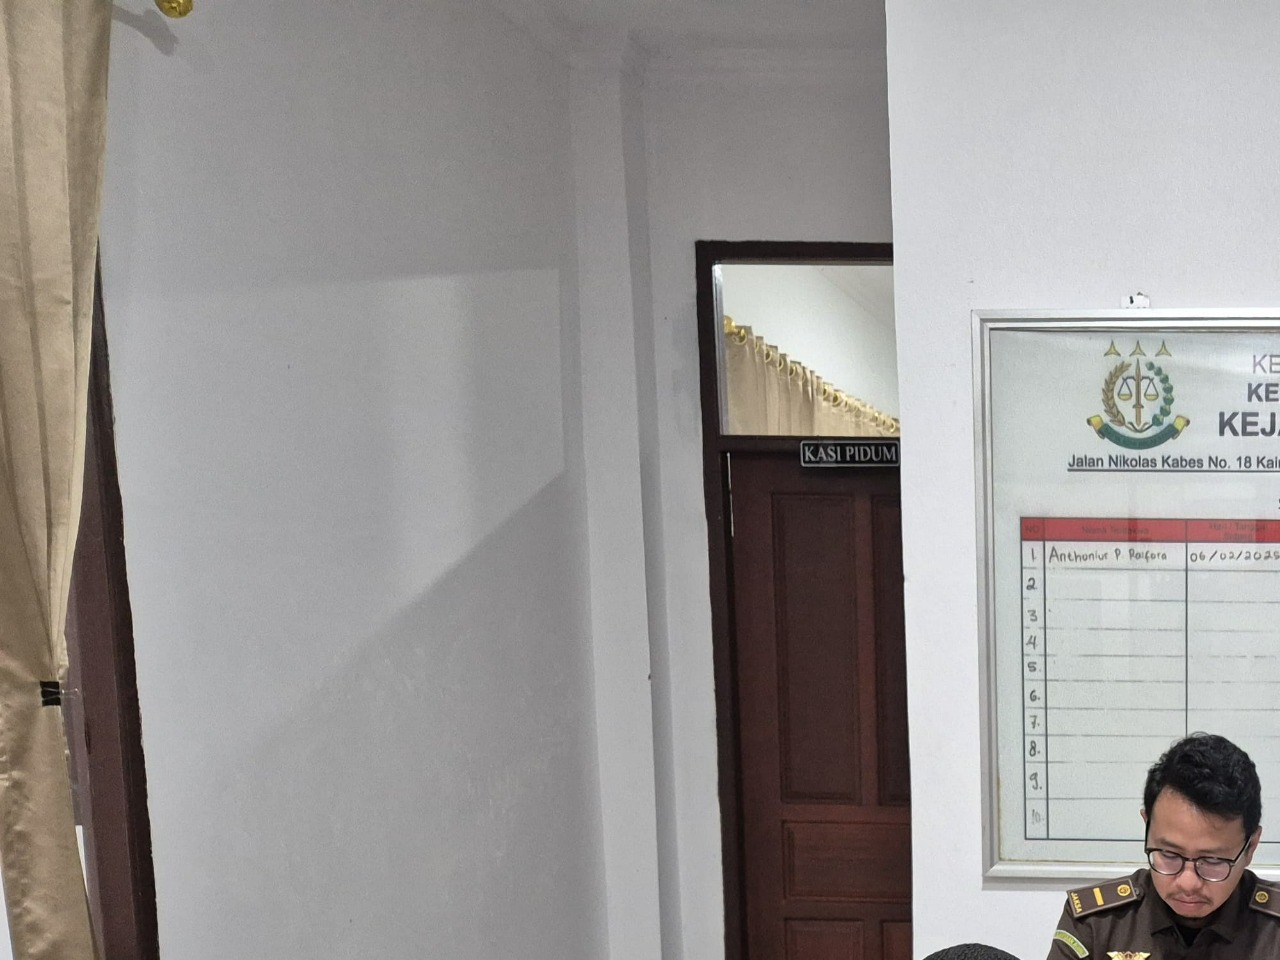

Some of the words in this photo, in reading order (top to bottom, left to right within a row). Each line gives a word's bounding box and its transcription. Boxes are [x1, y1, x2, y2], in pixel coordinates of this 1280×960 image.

[804, 446, 842, 462] KASI
[845, 446, 897, 462] PIDUM
[1068, 454, 1104, 468] Jalan
[1108, 455, 1158, 469] Nikolas
[1161, 455, 1204, 469] Kabes
[1208, 456, 1231, 469] No.
[1236, 456, 1252, 469] 18
[1029, 689, 1041, 703] 6.
[1029, 740, 1041, 758] 8.
[1029, 771, 1043, 791] 9.
[1070, 891, 1083, 914] JAKSA
